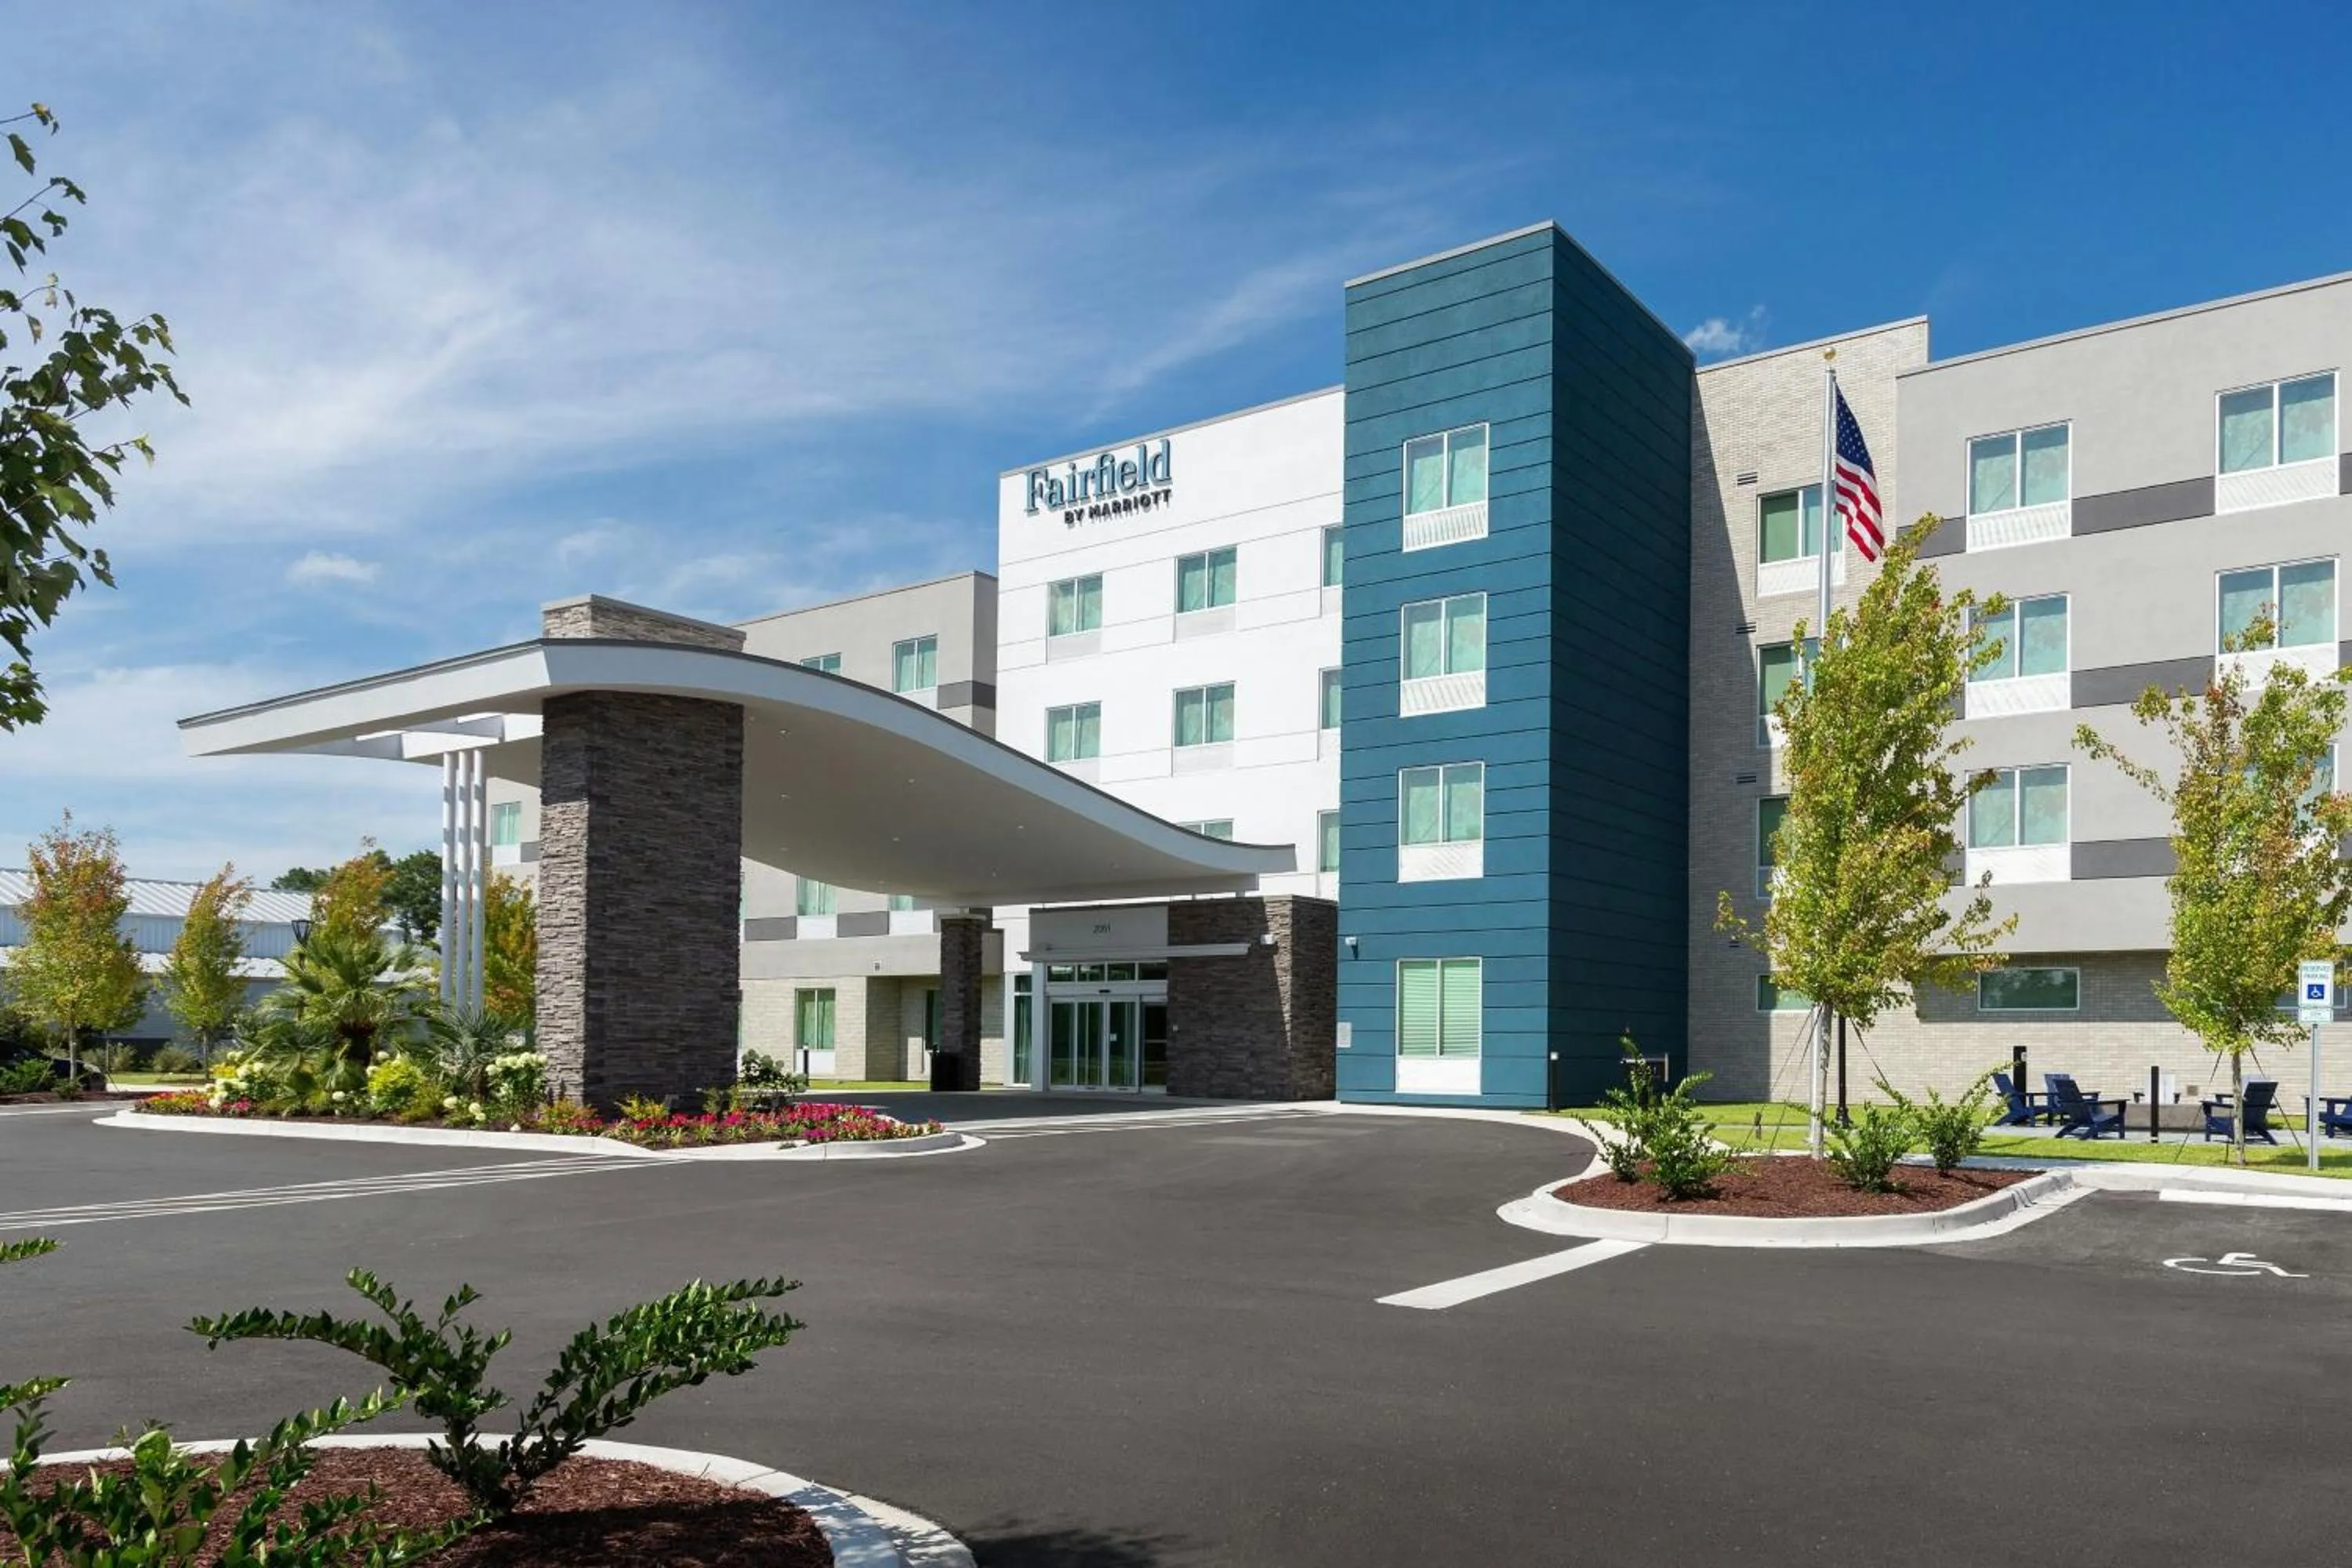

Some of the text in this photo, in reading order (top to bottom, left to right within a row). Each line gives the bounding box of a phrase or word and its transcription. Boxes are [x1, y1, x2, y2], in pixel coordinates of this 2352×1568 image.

[1023, 438, 1172, 515] Fairfield
[1064, 489, 1171, 525] BY MARRIOTT
